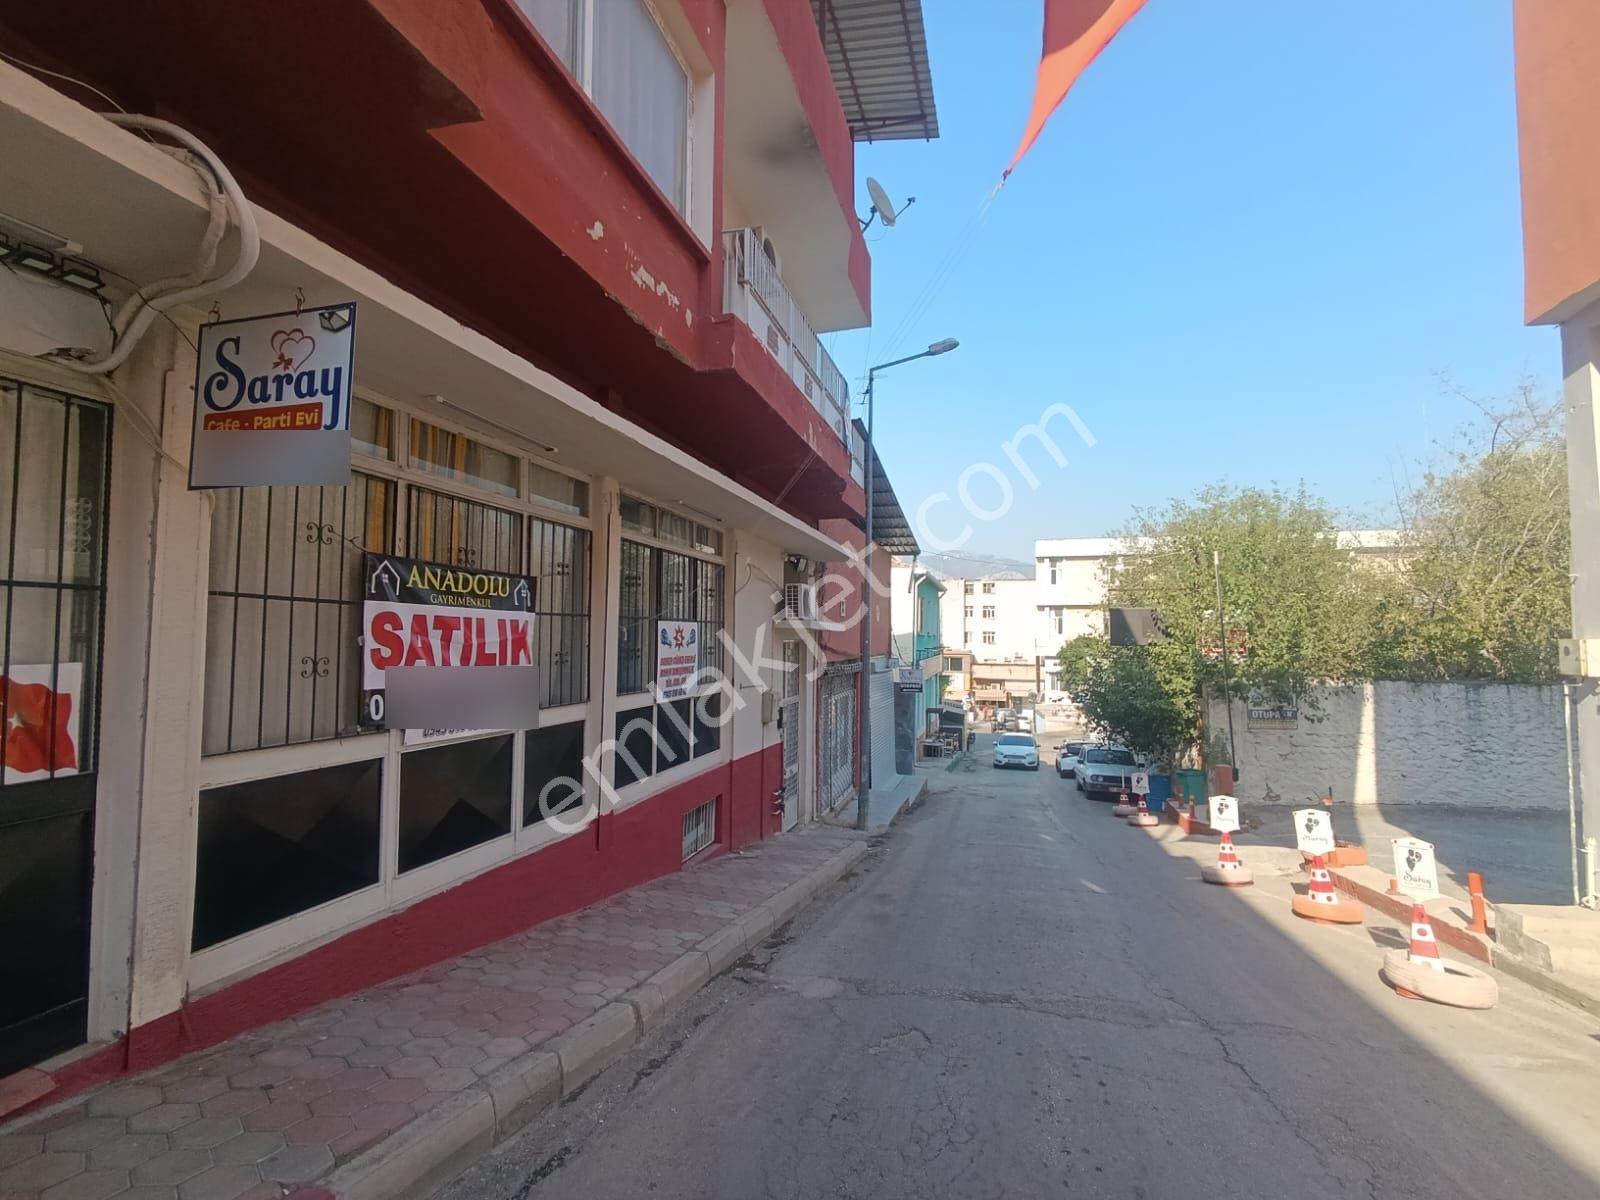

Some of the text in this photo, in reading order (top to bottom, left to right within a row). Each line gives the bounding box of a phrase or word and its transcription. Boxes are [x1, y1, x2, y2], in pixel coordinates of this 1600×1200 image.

[204, 336, 342, 430] Saray
[207, 418, 240, 430] Cafe
[253, 412, 290, 430] Parti
[296, 409, 319, 425] Evi
[406, 565, 511, 597] ANADOLU
[370, 611, 532, 670] SATILIK
[1252, 710, 1293, 719] OTOPAK
